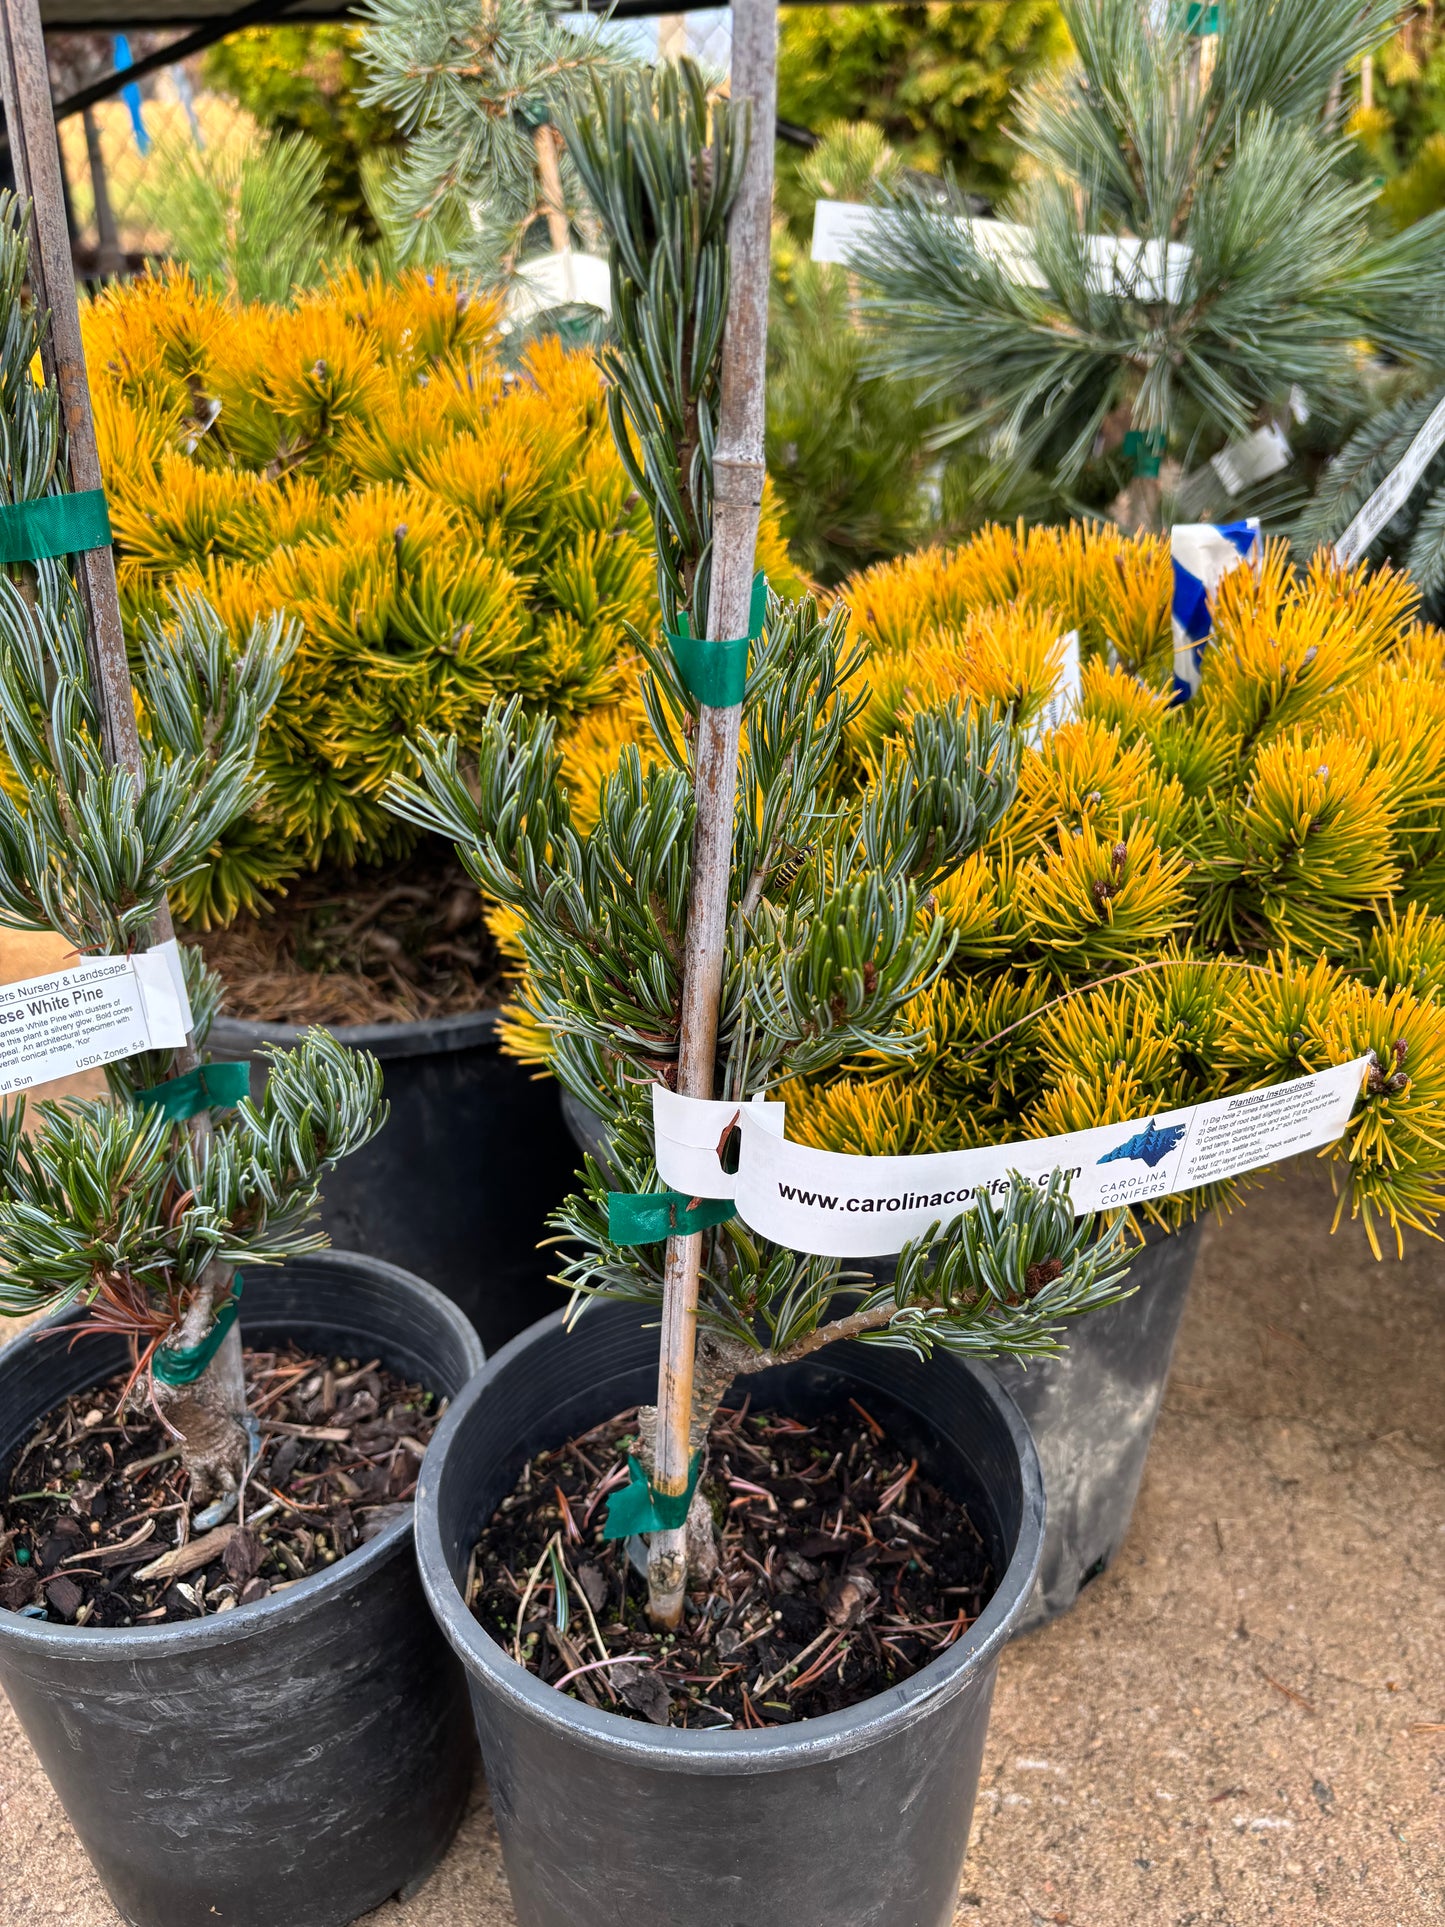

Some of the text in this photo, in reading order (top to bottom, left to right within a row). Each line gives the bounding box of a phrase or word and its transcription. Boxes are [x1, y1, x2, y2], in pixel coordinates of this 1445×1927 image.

[18, 981, 59, 997] Nursery
[63, 976, 70, 986] &
[72, 964, 126, 983] Landscape
[25, 1020, 48, 1030] White
[50, 1015, 67, 1024] Pine
[68, 1010, 84, 1018] with
[85, 1003, 112, 1014] clusters
[114, 998, 120, 1006] of
[26, 997, 69, 1016] White
[72, 989, 103, 1005] Pine
[7, 1038, 21, 1046] this
[23, 1031, 42, 1043] plant
[51, 1023, 73, 1034] silvery
[96, 1011, 112, 1021] Bold
[113, 1006, 133, 1016] cones
[23, 1044, 34, 1052] An
[36, 1030, 80, 1048] architectural
[82, 1021, 115, 1035] specimen
[116, 1016, 130, 1024] with
[21, 1049, 48, 1062] conical
[76, 1054, 102, 1068] USDA
[103, 1047, 128, 1060] Zones
[14, 1076, 33, 1086] Sun
[1228, 1079, 1317, 1110] Planting Instructions:
[1237, 1117, 1249, 1125] root
[1250, 1113, 1261, 1122] ball
[1262, 1108, 1282, 1118] slightly
[1283, 1103, 1300, 1112] above
[1301, 1095, 1321, 1107] ground
[1242, 1107, 1258, 1115] times
[1270, 1099, 1285, 1107] width
[1200, 1144, 1213, 1152] and
[1282, 1120, 1293, 1128] soil
[1204, 1131, 1231, 1143] Combine
[1231, 1125, 1256, 1136] planting
[1268, 1117, 1279, 1125] and
[1308, 1101, 1327, 1113] ground
[1195, 1163, 1208, 1172] Add
[1222, 1156, 1237, 1164] layer
[1265, 1141, 1282, 1150] Check
[1283, 1136, 1298, 1144] water
[1199, 1152, 1217, 1161] Water
[1099, 1169, 1167, 1194] CAROLINA
[1192, 1168, 1222, 1180] frequently
[1101, 1182, 1167, 1206] CONIFERS
